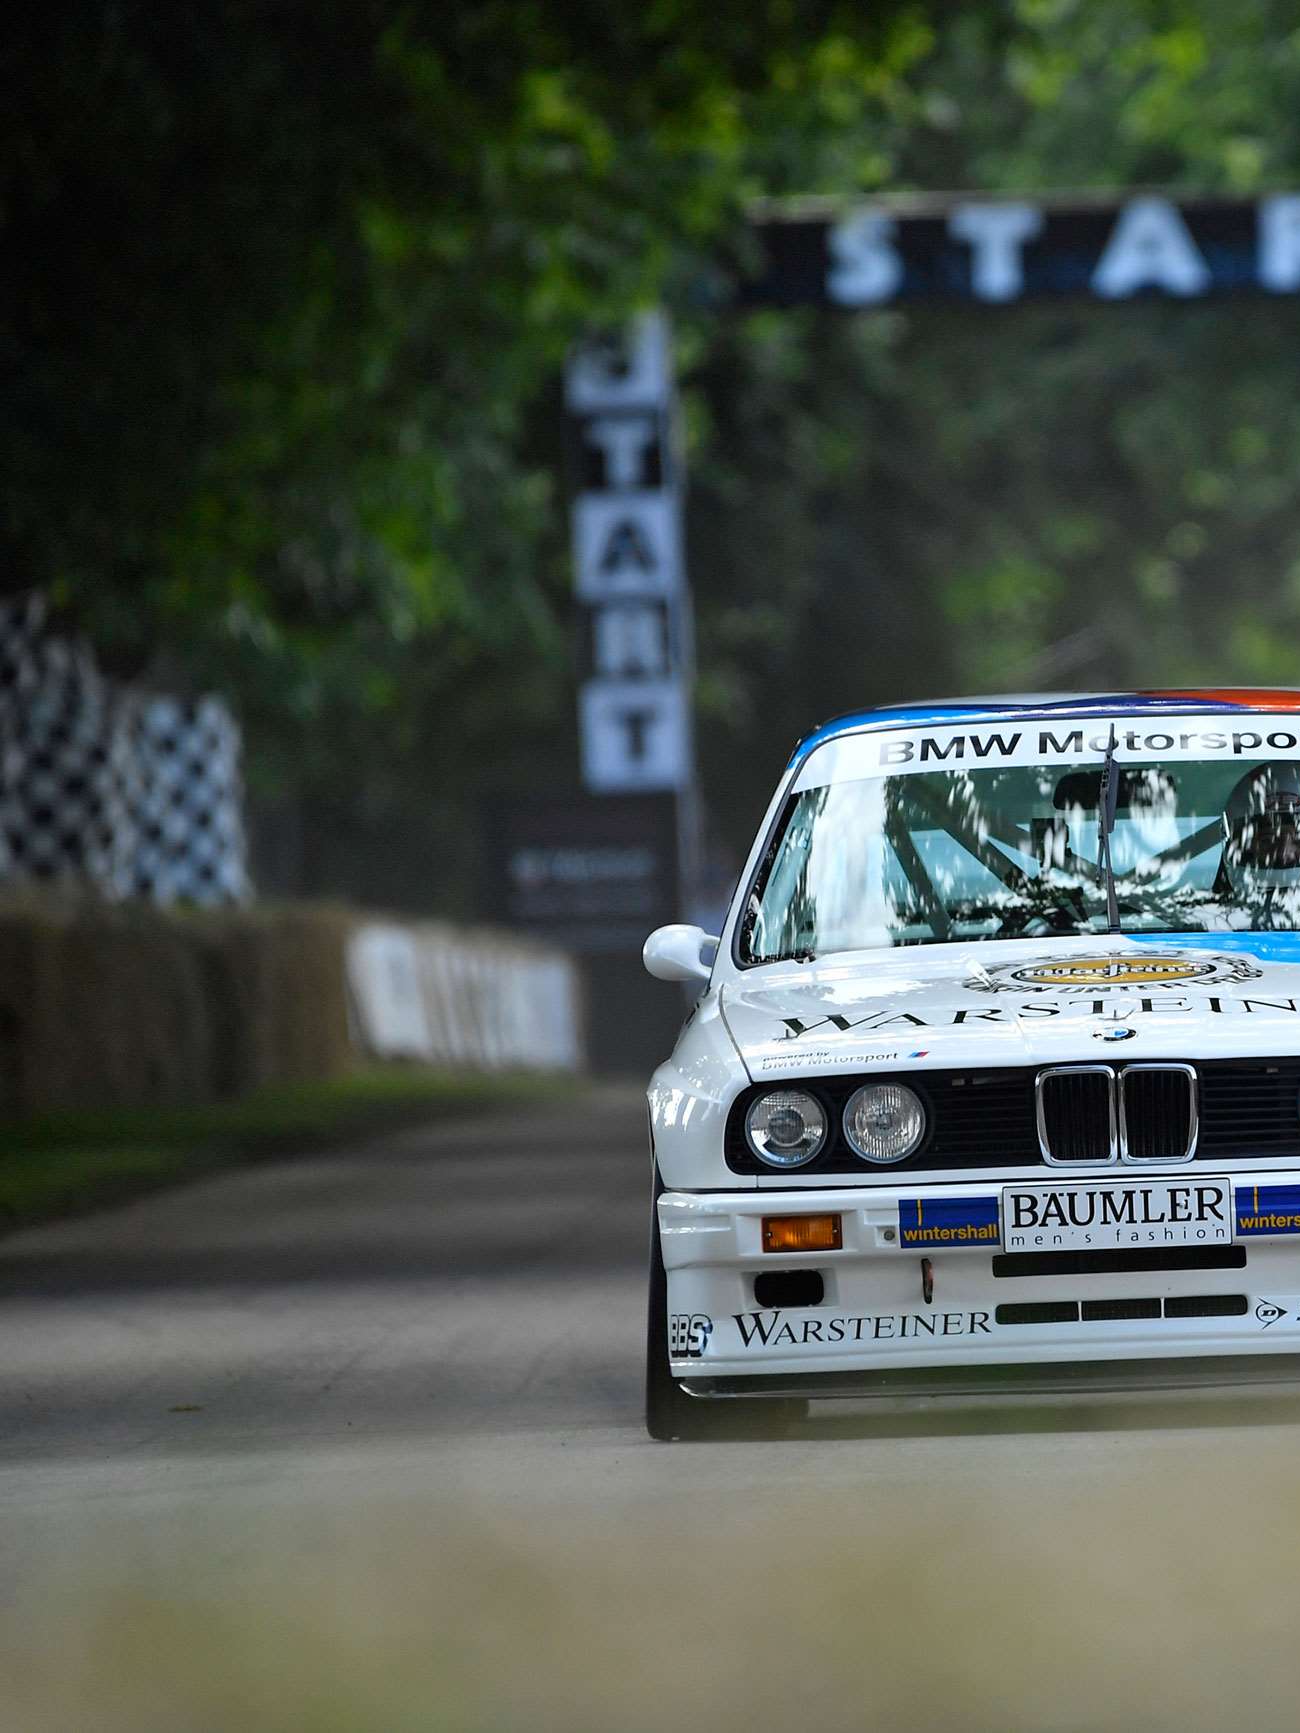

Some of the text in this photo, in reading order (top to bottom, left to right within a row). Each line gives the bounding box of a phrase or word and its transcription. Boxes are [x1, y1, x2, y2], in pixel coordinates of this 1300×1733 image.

[878, 732, 1022, 765] BMW
[1010, 1186, 1225, 1229] BÄUMLER
[903, 1222, 999, 1243] wintershall
[1010, 1223, 1227, 1246] men's fashion
[731, 1310, 993, 1348] WARSTEINER
